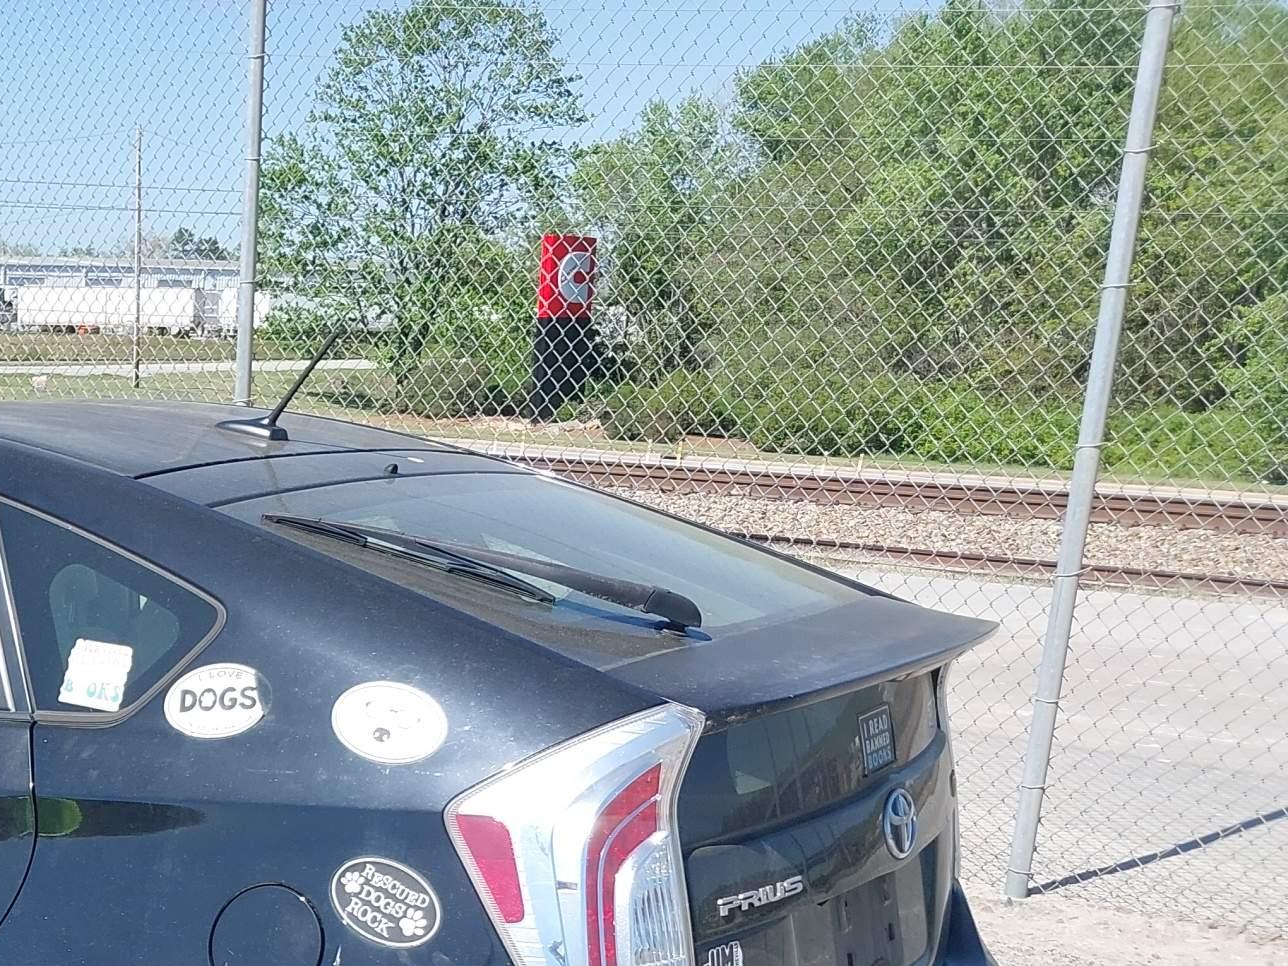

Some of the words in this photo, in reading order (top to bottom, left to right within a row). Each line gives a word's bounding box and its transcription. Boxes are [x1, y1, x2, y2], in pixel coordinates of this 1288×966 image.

[209, 670, 244, 680] LOVE
[179, 686, 258, 713] DOGS
[869, 714, 888, 734] READ
[865, 731, 890, 754] BANNED
[868, 746, 892, 770] BOOKS
[360, 863, 430, 908] RESCUED
[717, 875, 803, 917] PRIUS
[358, 884, 407, 918] DOGS
[345, 897, 396, 938] ROCK
